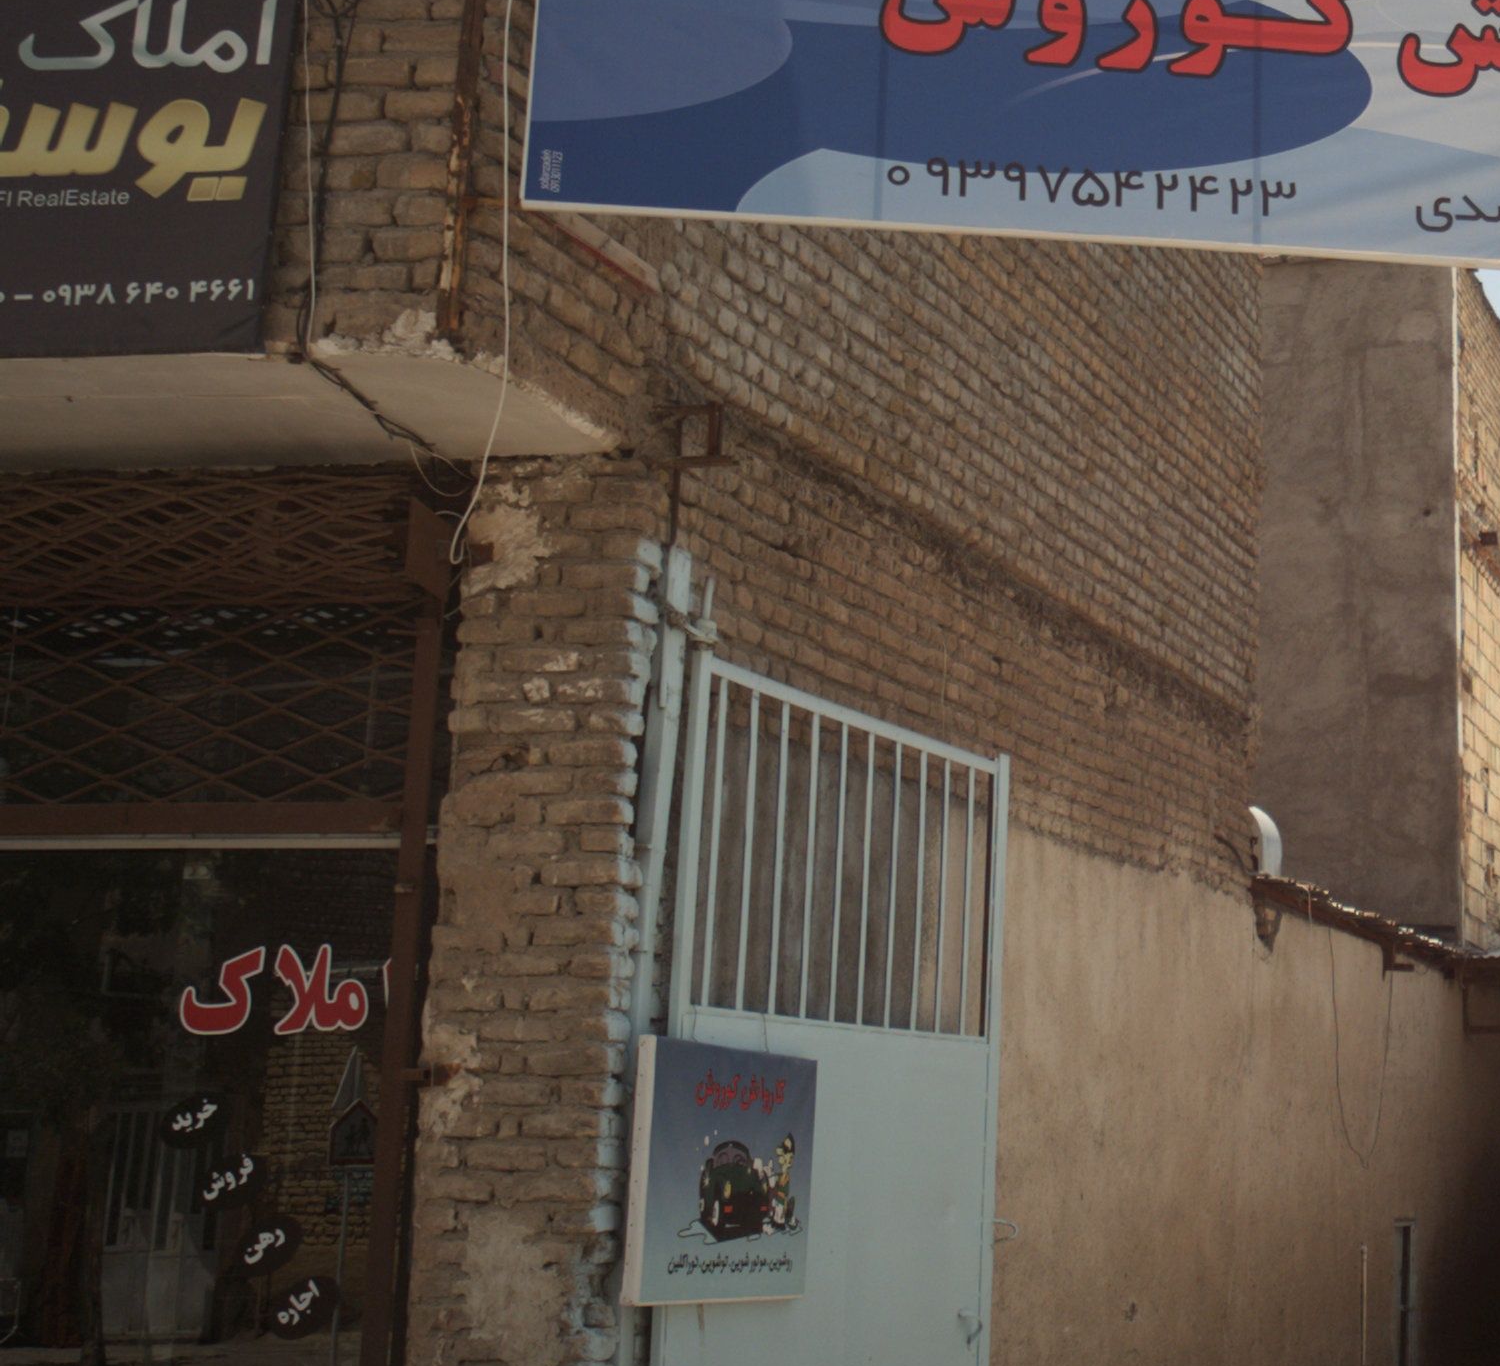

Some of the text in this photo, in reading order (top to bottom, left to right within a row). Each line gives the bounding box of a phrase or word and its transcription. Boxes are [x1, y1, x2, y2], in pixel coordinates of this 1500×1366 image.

[0, 97, 268, 202] یوس
[171, 1097, 218, 1133] خرید
[695, 1068, 786, 1115] کارواش کوروش
[203, 1154, 254, 1202] فروش
[243, 1227, 286, 1265] رهن
[276, 1279, 321, 1326] اجاره
